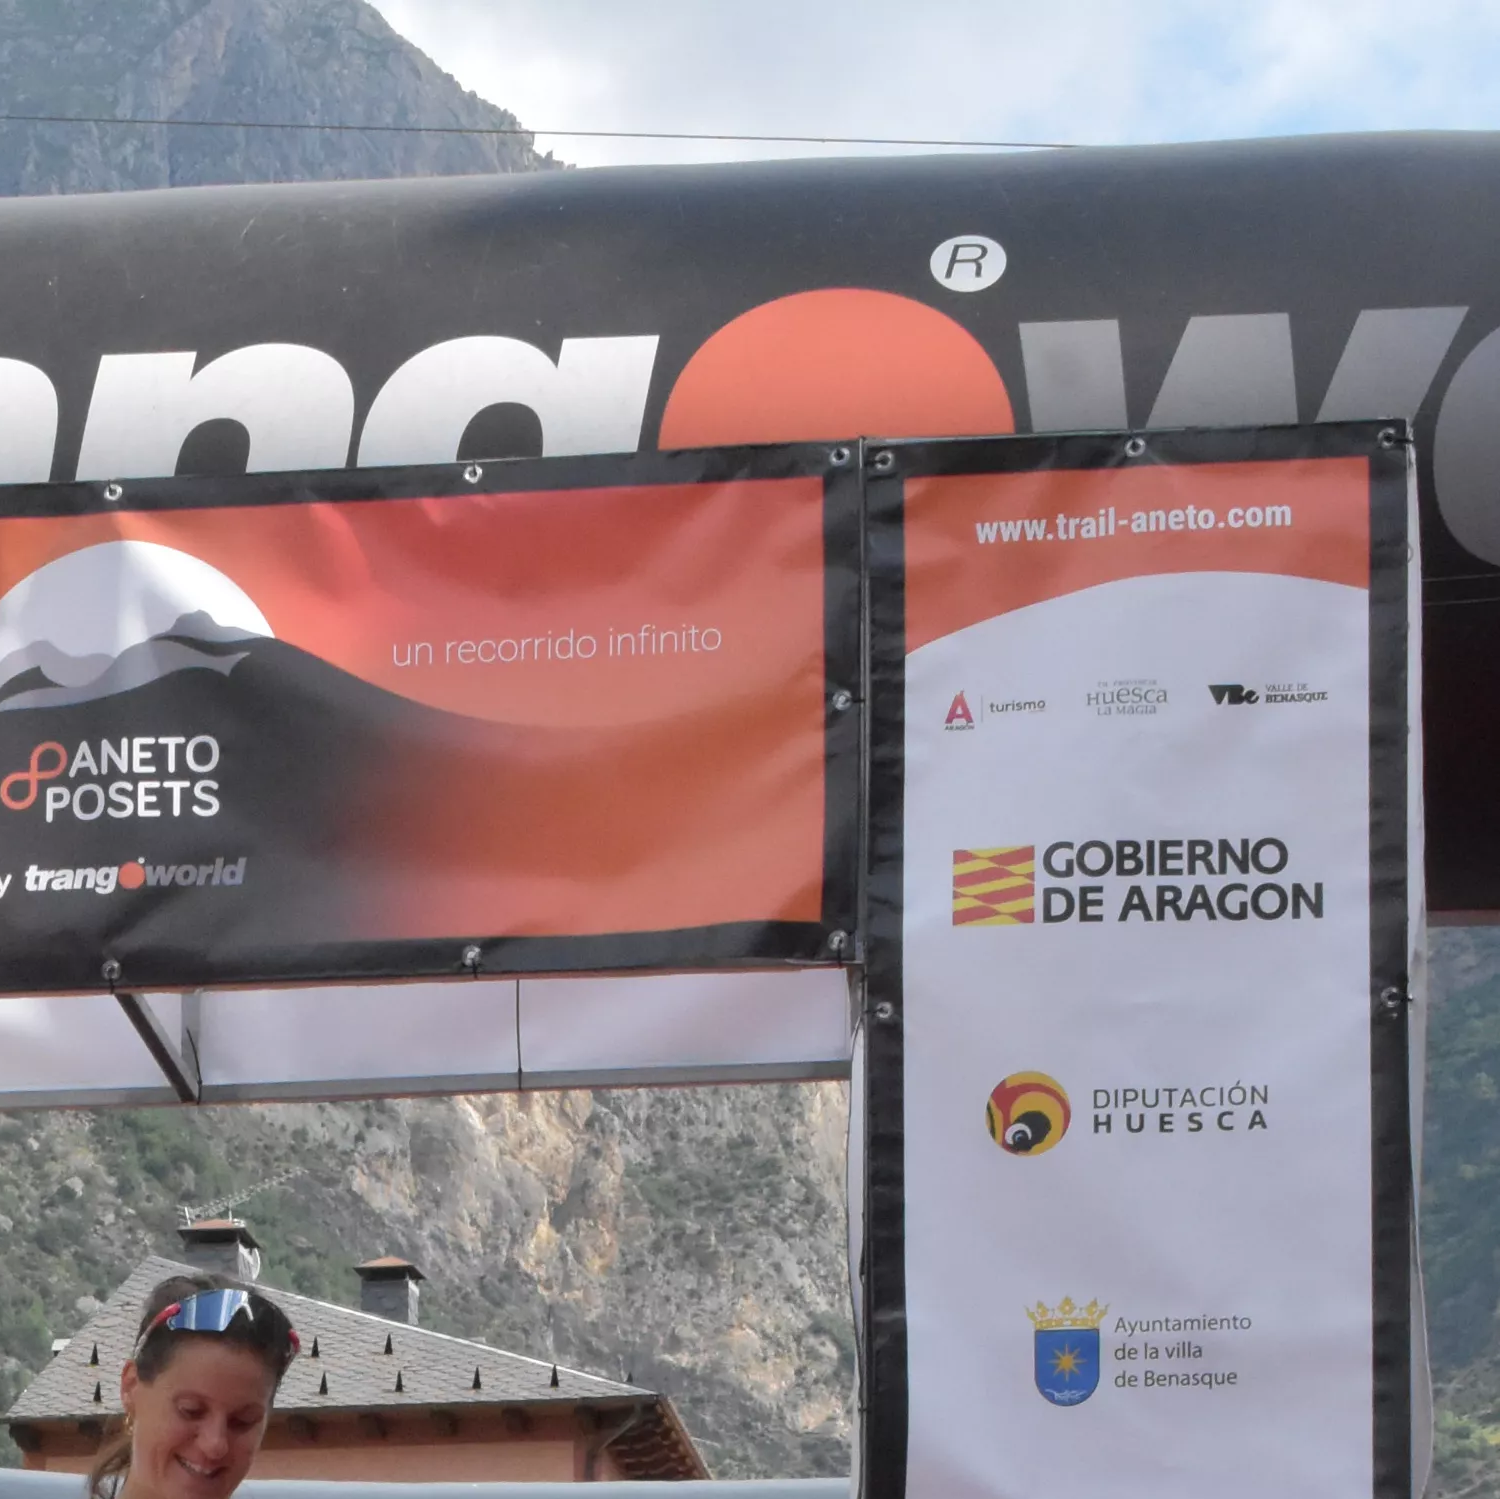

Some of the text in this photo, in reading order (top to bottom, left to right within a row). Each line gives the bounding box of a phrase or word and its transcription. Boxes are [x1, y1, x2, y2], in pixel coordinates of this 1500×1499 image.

[976, 503, 1293, 544] www.trail-aneto.com
[392, 624, 722, 667] un recorrido infinito
[1265, 683, 1308, 692] VALLE DE
[1265, 691, 1328, 704] BENASQUE
[989, 698, 1046, 714] turismo
[68, 735, 219, 777] ANETO
[45, 779, 220, 822] POSETS
[1042, 837, 1288, 879] GOBIERNO
[1042, 882, 1324, 923] DE ARAGON
[1093, 1081, 1269, 1110] DIPUTACIÓN
[1093, 1110, 1268, 1134] HUESCA
[1114, 1313, 1252, 1336] Ayuntamiento
[1114, 1341, 1203, 1362] de la villa
[1114, 1369, 1238, 1391] de Benasque
